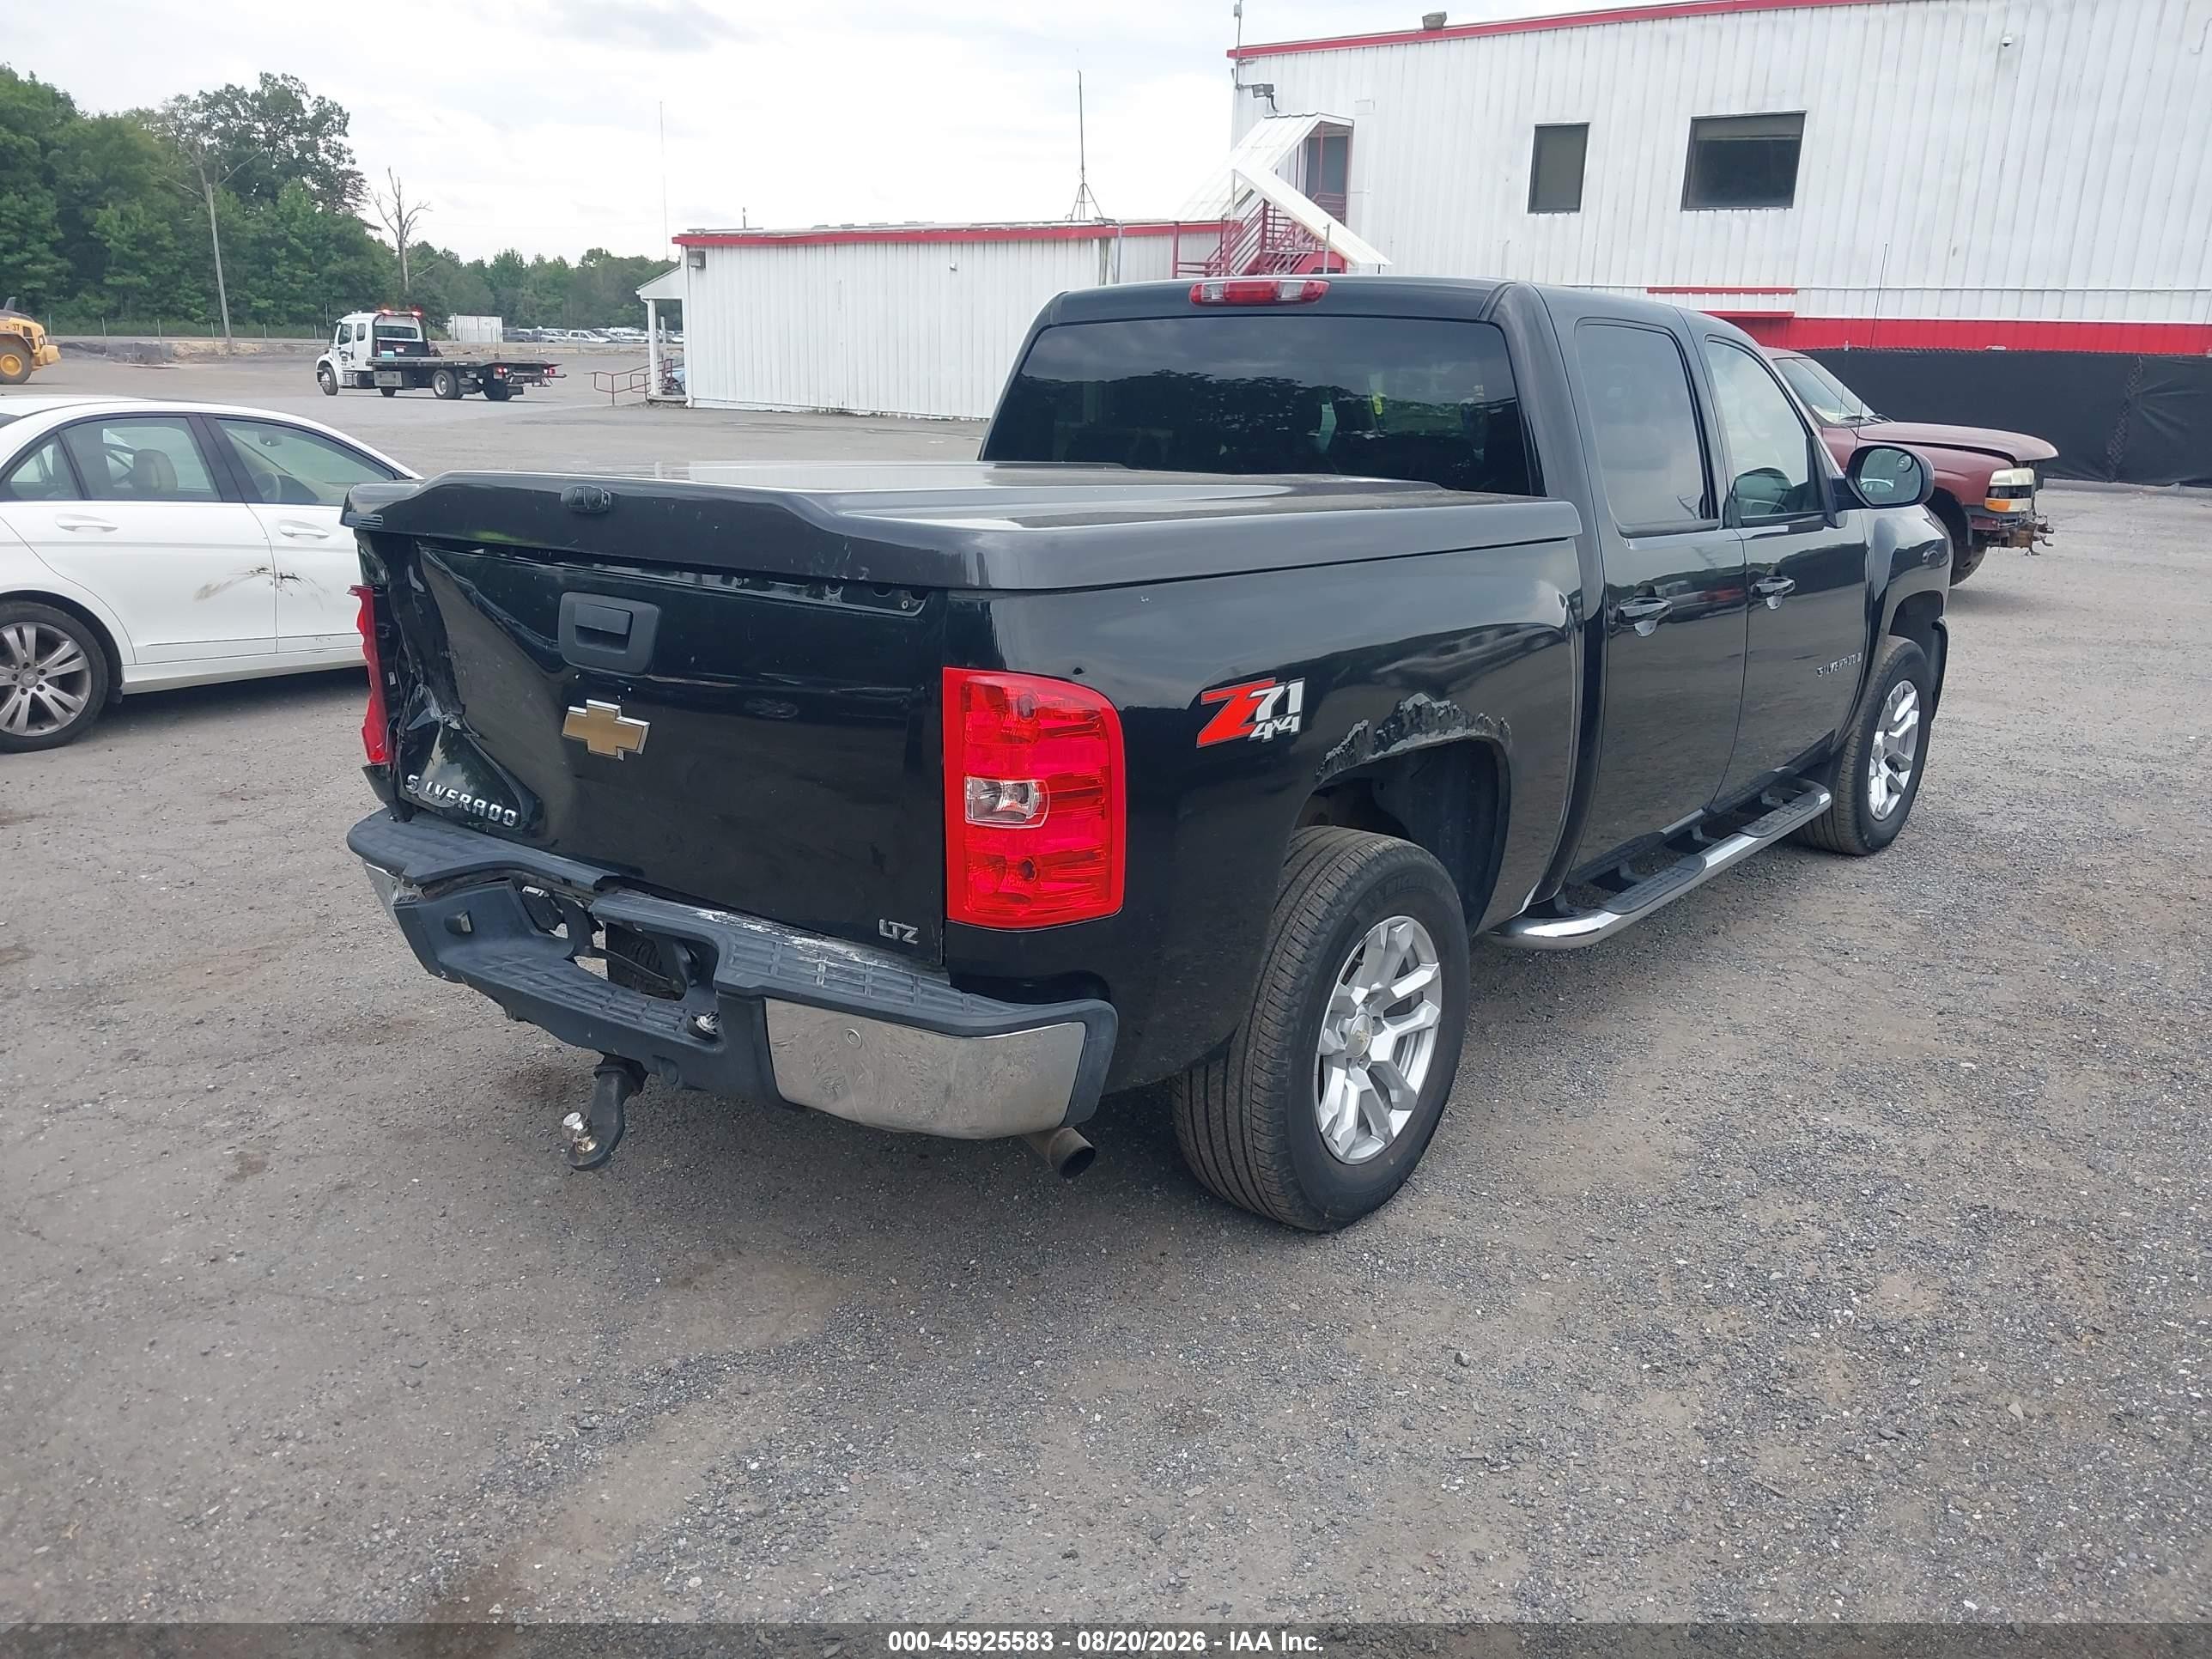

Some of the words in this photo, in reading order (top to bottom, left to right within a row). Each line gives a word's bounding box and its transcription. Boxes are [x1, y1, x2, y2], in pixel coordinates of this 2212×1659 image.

[1196, 677, 1306, 748] Z71
[405, 774, 517, 827] SLVERADO
[878, 919, 919, 945] LTZ
